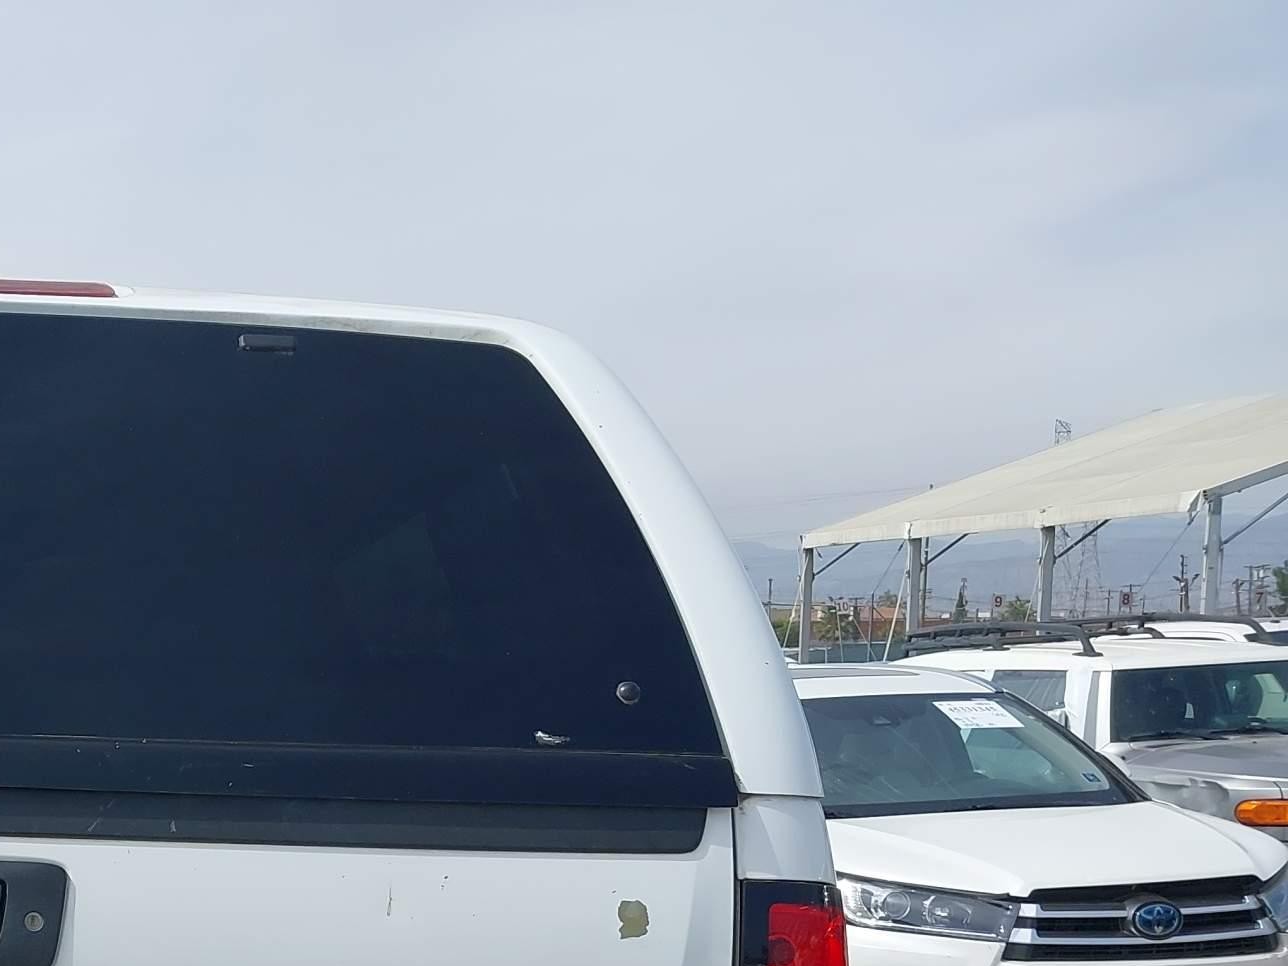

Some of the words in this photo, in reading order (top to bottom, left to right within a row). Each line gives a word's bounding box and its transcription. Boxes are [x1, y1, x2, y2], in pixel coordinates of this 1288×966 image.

[994, 596, 1003, 607] 9
[1122, 593, 1130, 605] 8
[1255, 592, 1264, 604] 7
[837, 601, 849, 612] 10
